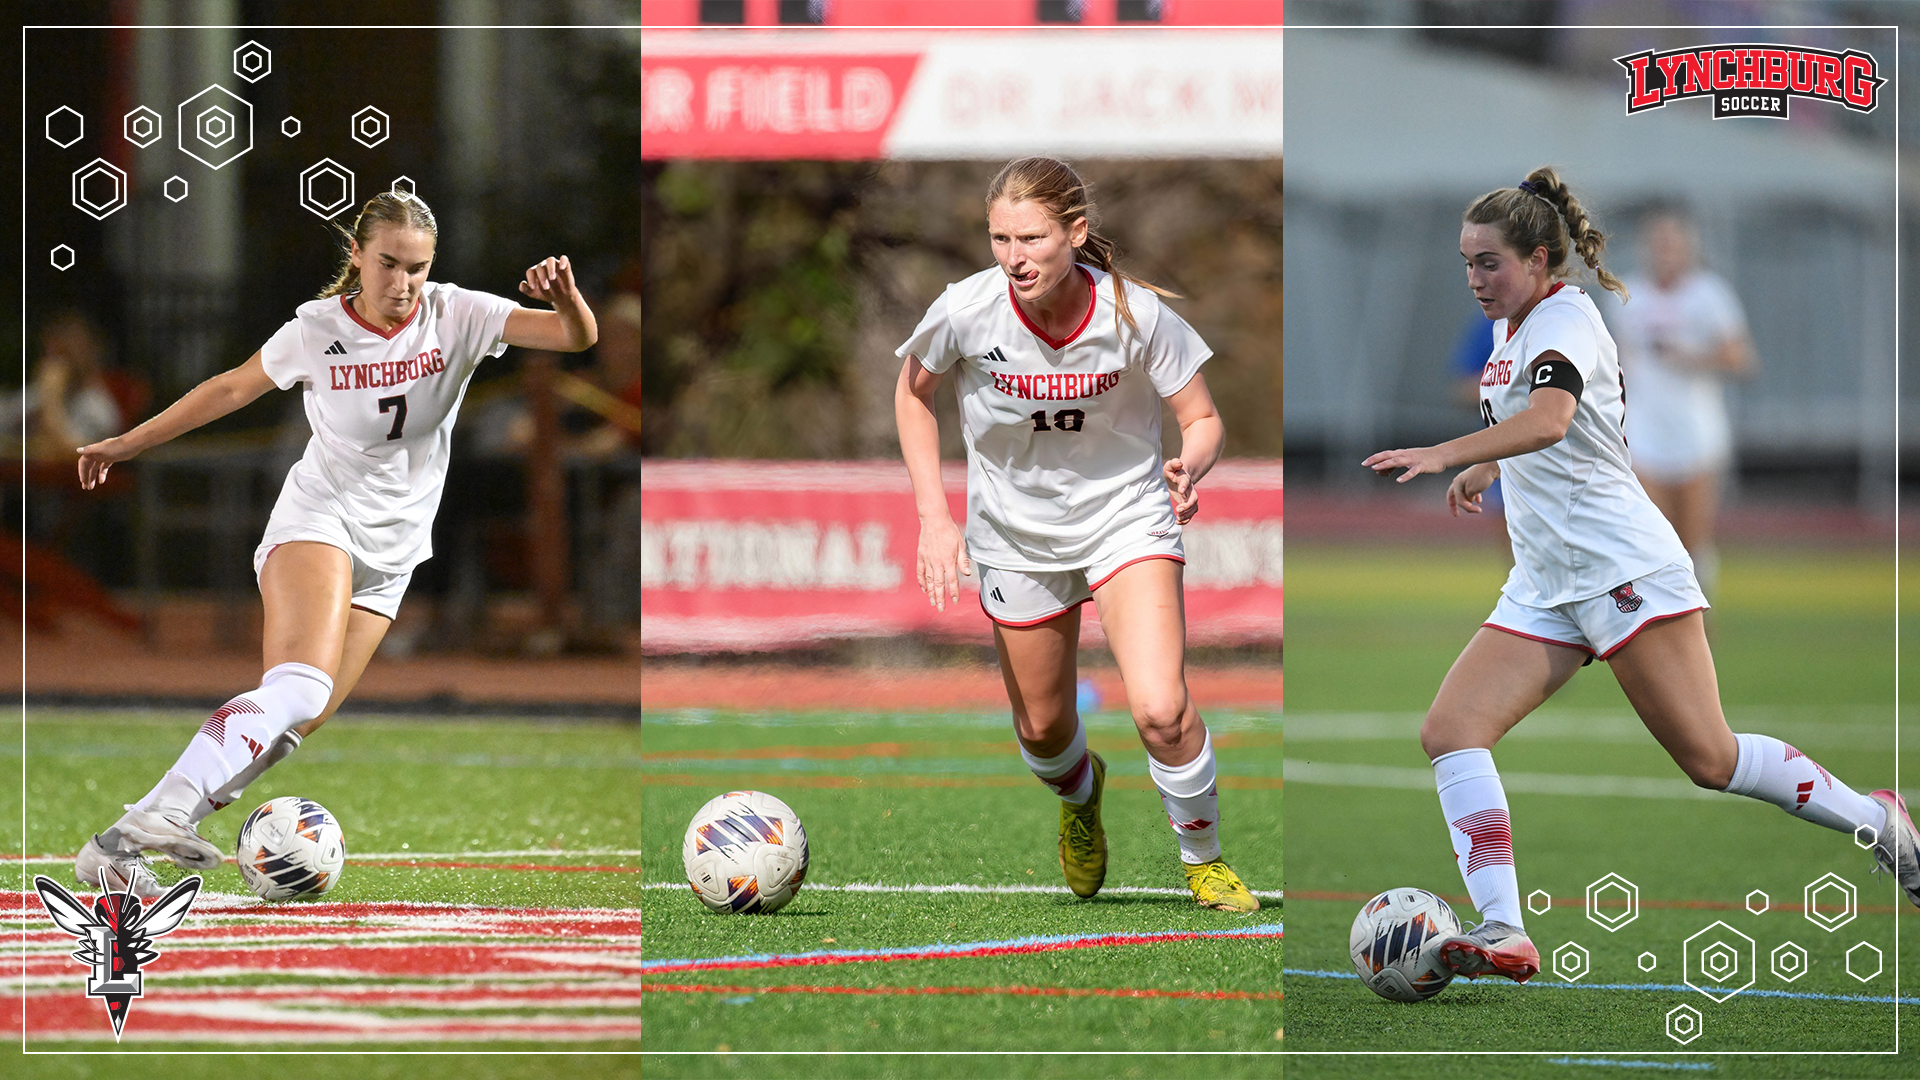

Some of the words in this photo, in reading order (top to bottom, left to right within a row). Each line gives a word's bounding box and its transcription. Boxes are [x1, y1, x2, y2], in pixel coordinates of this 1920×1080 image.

[641, 66, 695, 133] R
[706, 66, 893, 133] FIELD
[329, 348, 445, 390] LYNCHBURG
[990, 370, 1121, 400] LYNCHBURG
[1535, 364, 1553, 385] C
[378, 394, 408, 441] 7
